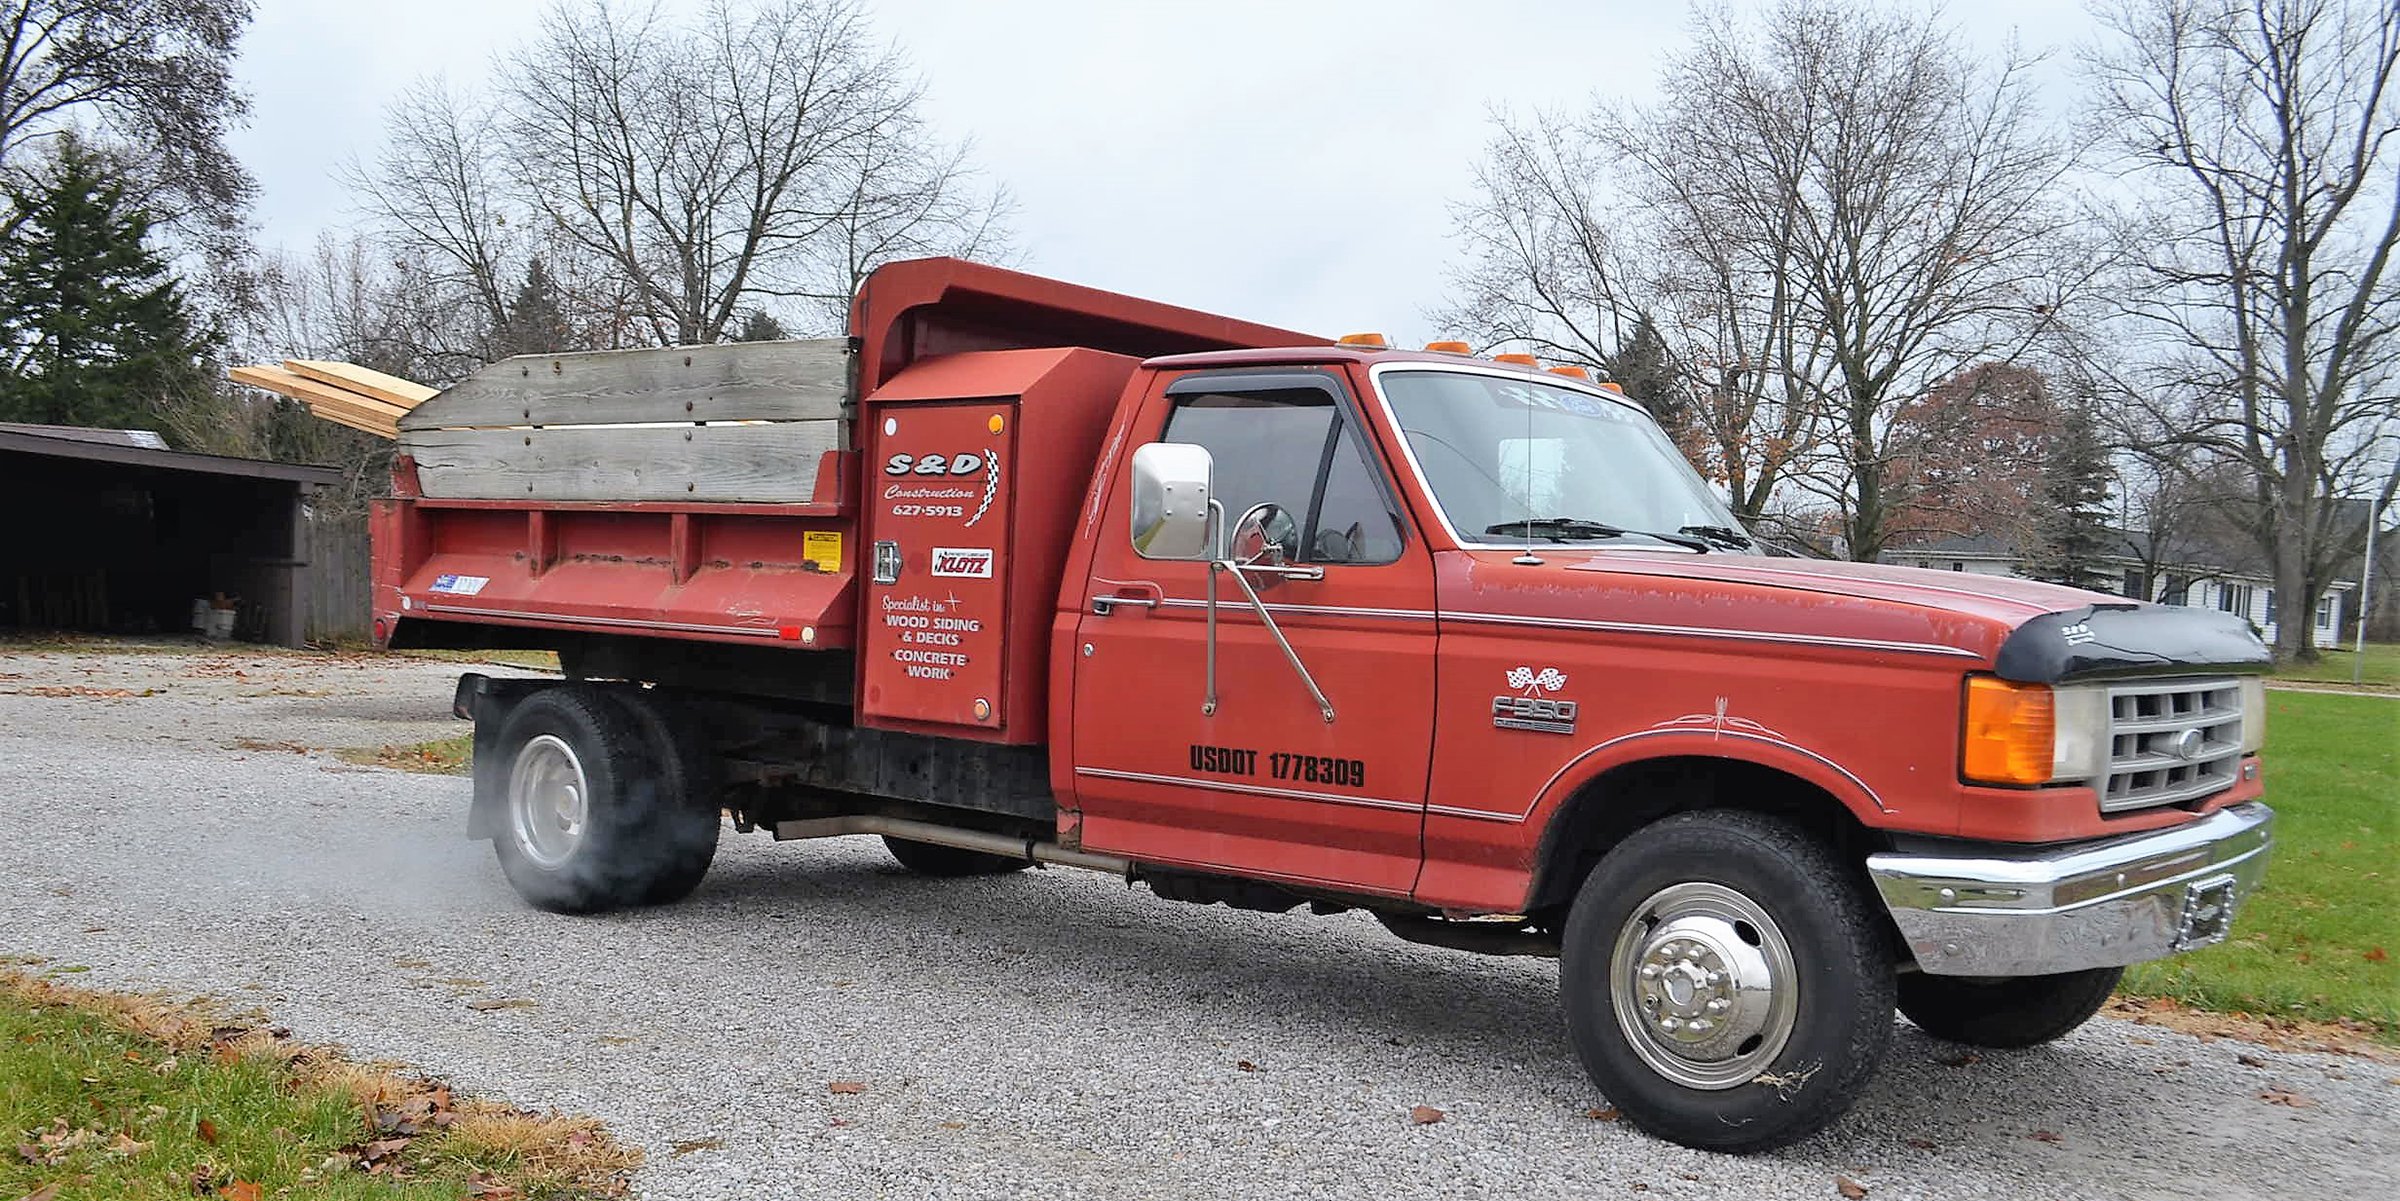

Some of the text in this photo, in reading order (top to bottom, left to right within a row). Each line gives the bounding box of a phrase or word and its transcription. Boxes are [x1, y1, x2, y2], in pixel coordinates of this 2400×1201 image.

[884, 452, 982, 476] S&D
[884, 484, 975, 499] Construction
[938, 556, 989, 574] KLOTZ
[882, 595, 931, 612] Specialist
[886, 614, 980, 632] WOOD SIDING
[903, 631, 959, 646] & DECKS
[894, 649, 967, 666] CONCRETE
[907, 665, 950, 680] WORK
[1190, 744, 1365, 788] USDOT 1778309
